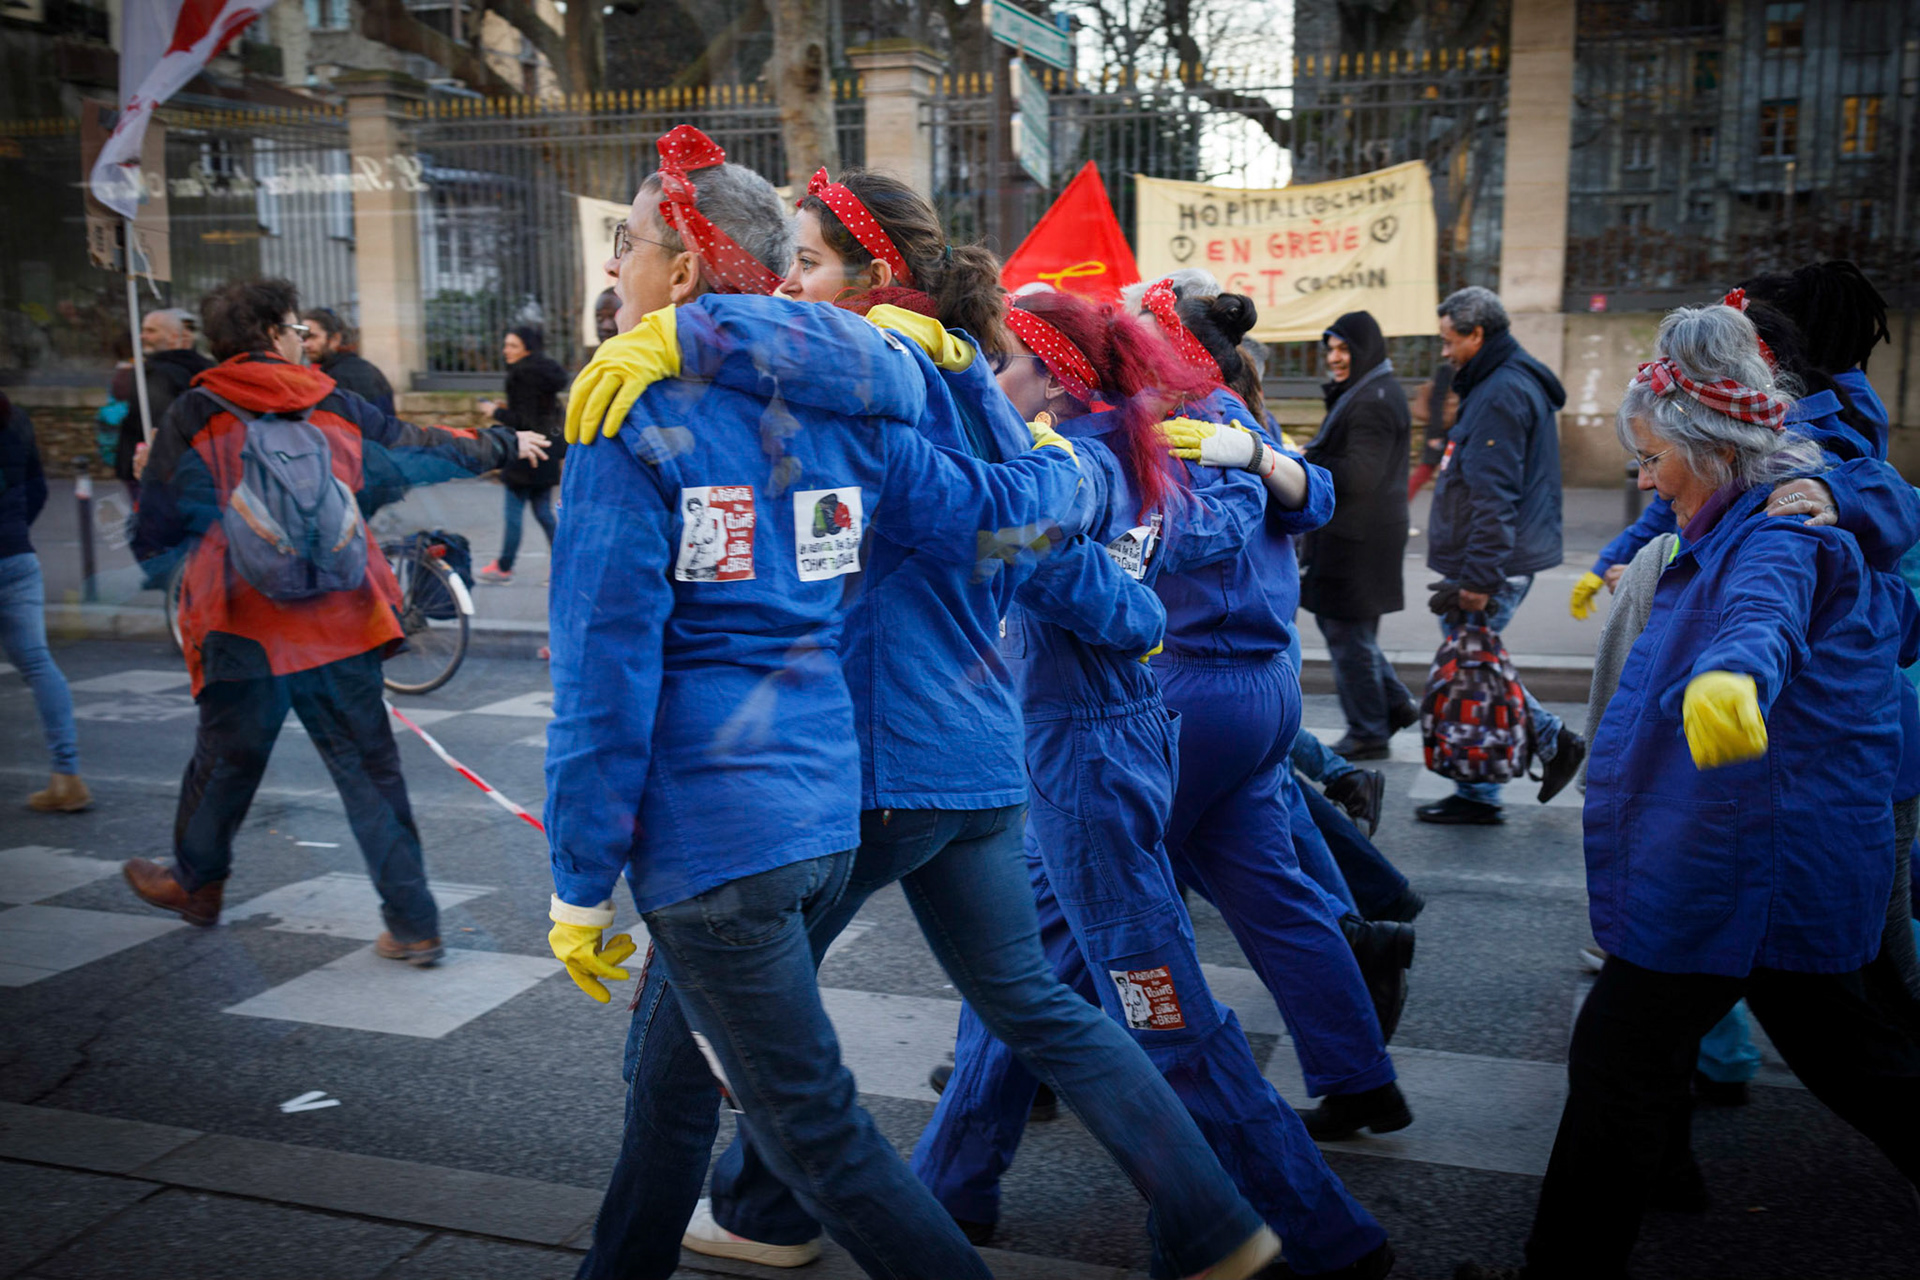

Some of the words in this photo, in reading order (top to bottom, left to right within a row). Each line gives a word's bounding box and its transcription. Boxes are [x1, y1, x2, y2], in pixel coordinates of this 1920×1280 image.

[1206, 238, 1250, 263] EN
[1267, 219, 1360, 260] GRÈVE
[1225, 269, 1284, 307] GT
[1294, 261, 1387, 295] COCHIN
